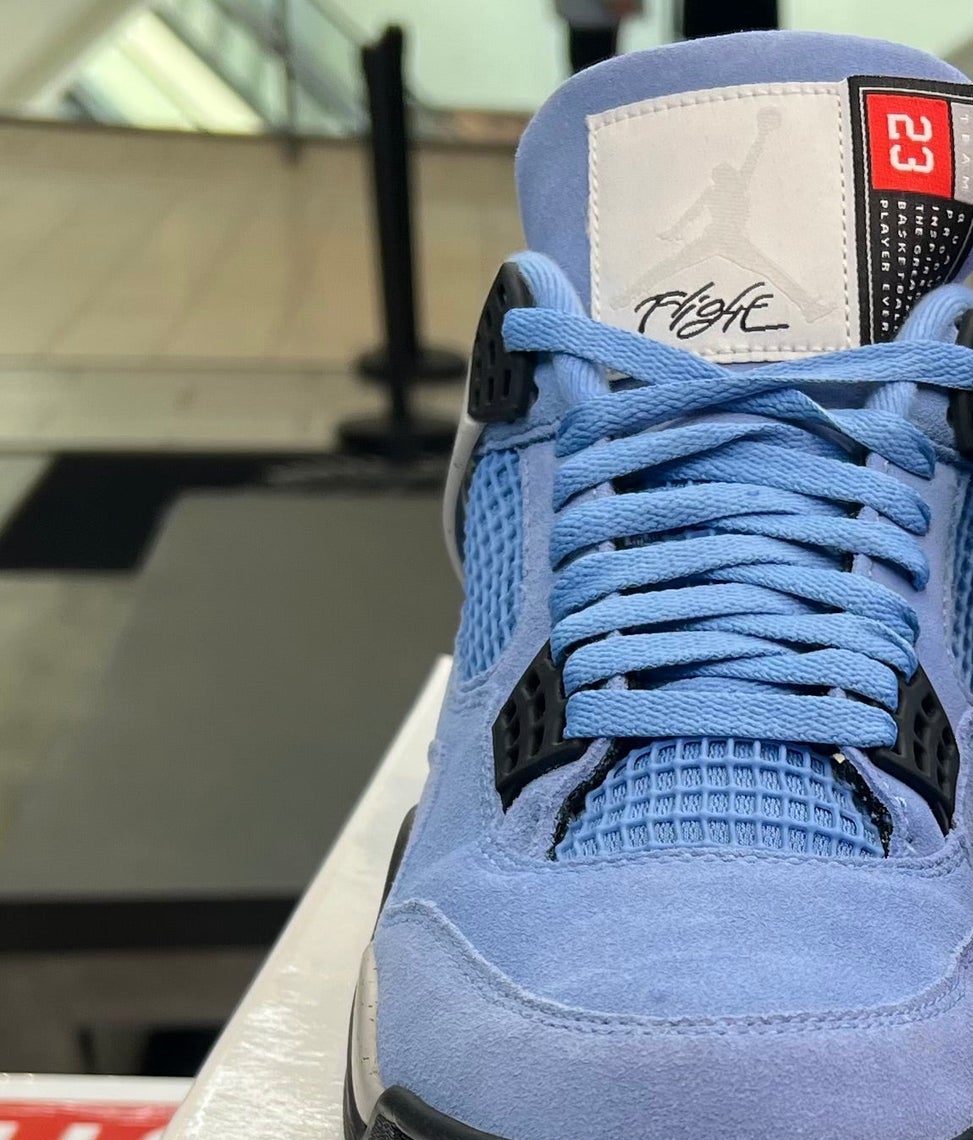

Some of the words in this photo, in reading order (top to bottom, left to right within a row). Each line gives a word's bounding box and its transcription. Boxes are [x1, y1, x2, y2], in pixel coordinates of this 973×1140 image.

[886, 113, 935, 173] 23
[961, 114, 970, 192] TEAM
[879, 199, 890, 272] PLAYER
[914, 204, 924, 236] THE
[893, 200, 908, 333] BASKETBALL
[634, 281, 790, 339] Flight
